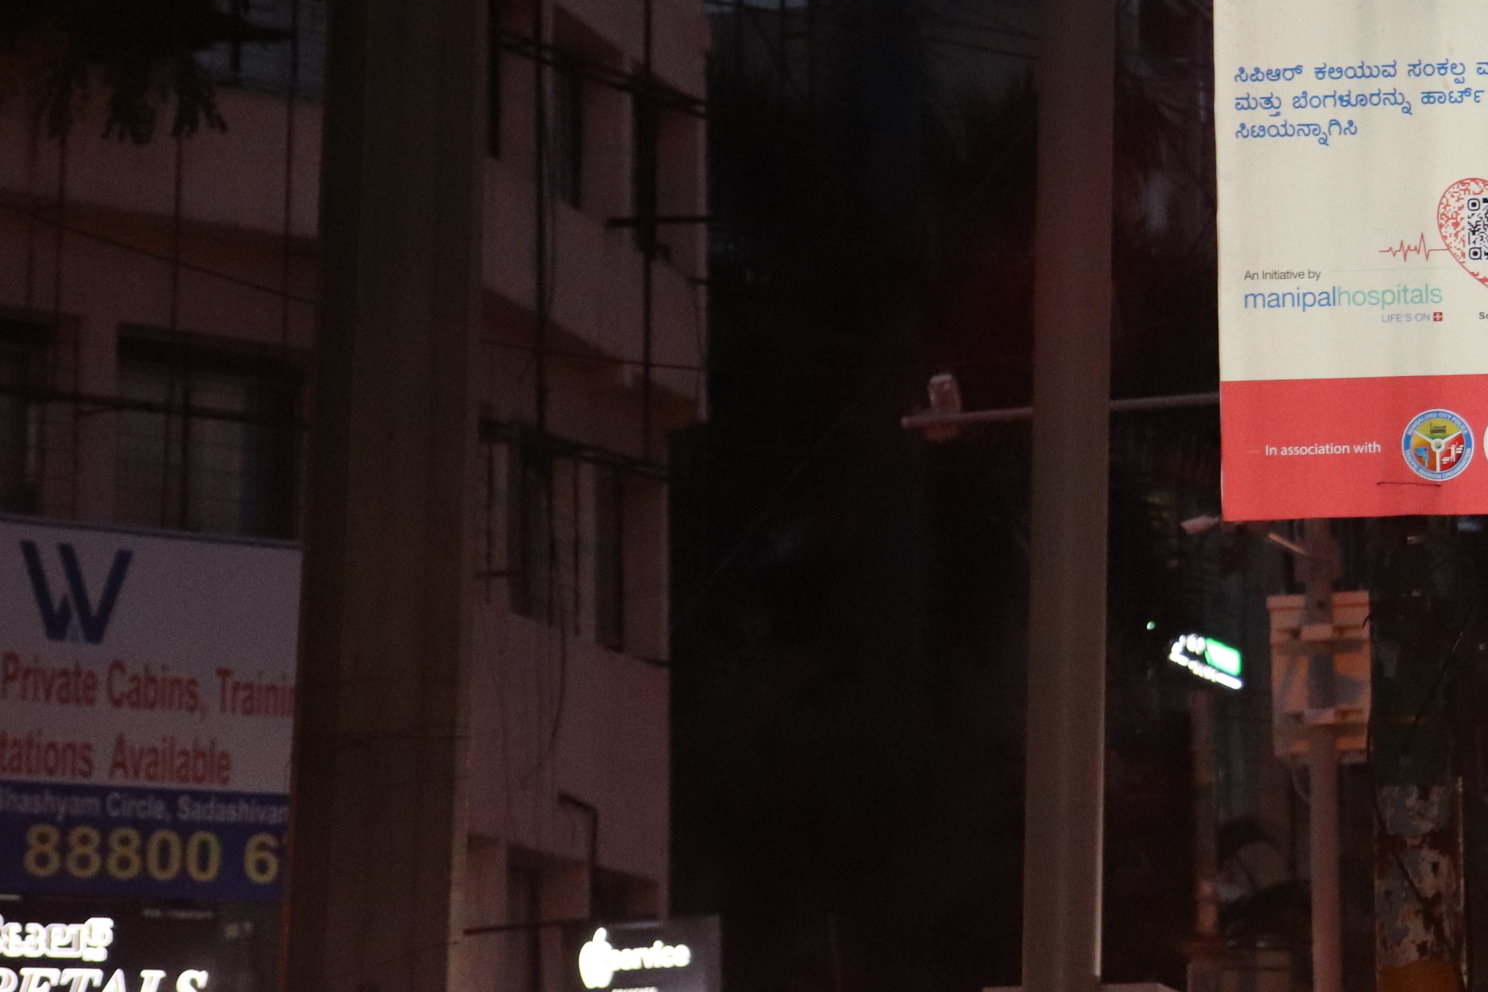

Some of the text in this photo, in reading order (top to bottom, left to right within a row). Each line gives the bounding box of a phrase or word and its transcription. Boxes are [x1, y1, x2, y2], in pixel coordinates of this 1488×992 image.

[1234, 64, 1303, 83] ಸಿಪಿಆರ್
[1314, 59, 1397, 80] ಕಲಿಯುವ
[1407, 58, 1466, 84] ಸಂಕಲ್ಪ
[1234, 92, 1282, 117] ಮತ್ತು
[1292, 88, 1413, 115] ಬೆಂಗಳೂರನ್ನು
[1420, 87, 1485, 105] ಹಾರ್ಟ್
[1235, 118, 1358, 146] ಸಿಟಿಯನ್ನಾಗಿಸಿ
[1243, 269, 1321, 281] An Initiative by
[1244, 283, 1443, 312] manipalhospitals
[1381, 313, 1431, 323] LIFE'S ON
[1265, 441, 1381, 456] In association with
[1, 653, 98, 707] Private
[110, 733, 232, 787] Available
[23, 823, 222, 883] 88800
